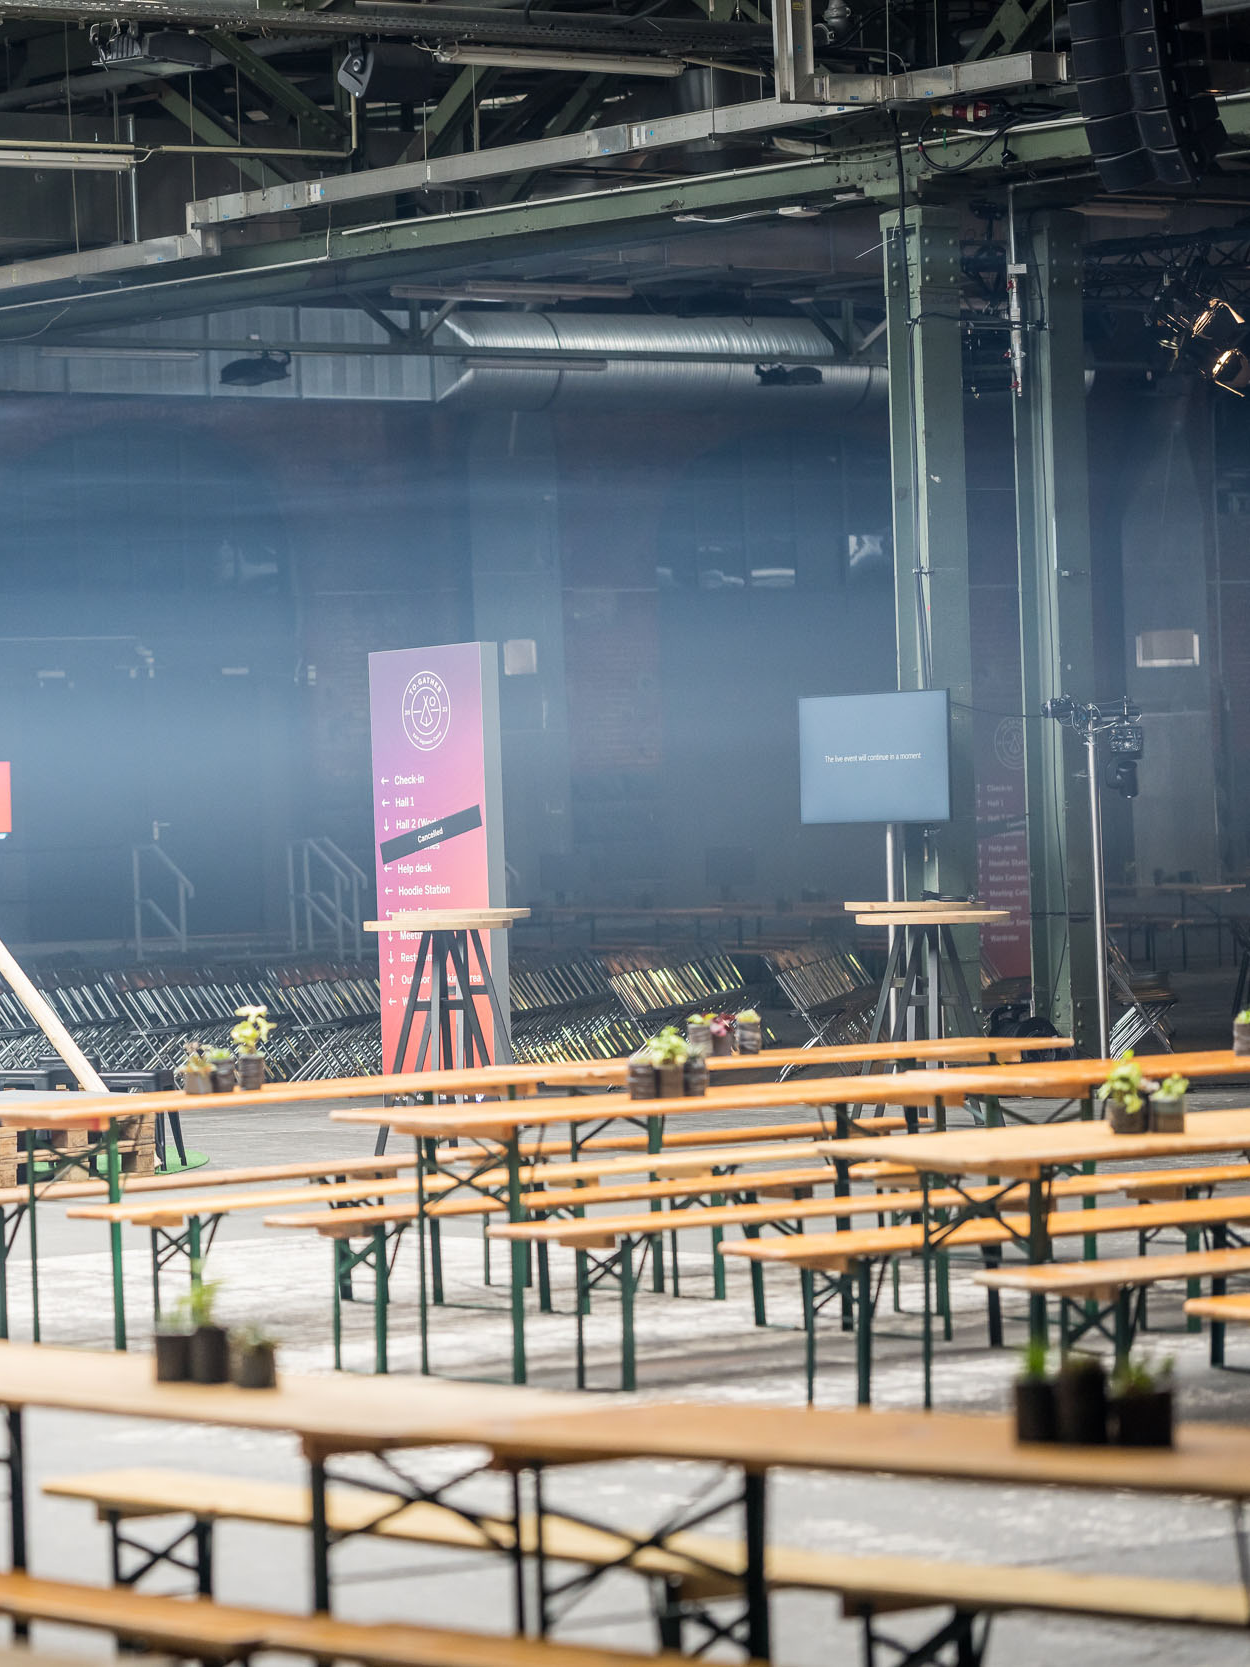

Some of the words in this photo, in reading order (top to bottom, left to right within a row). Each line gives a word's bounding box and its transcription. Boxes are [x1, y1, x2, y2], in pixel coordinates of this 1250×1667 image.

[825, 755, 834, 763] The
[394, 774, 425, 785] Check-in
[395, 797, 409, 808] Hall
[410, 797, 415, 807] 1
[396, 819, 410, 830] Hall
[411, 818, 416, 829] 2
[417, 826, 444, 843] Cancelled
[397, 864, 414, 875] Help
[415, 863, 432, 873] desk
[398, 886, 423, 896] Hoodie
[424, 884, 451, 895] Station
